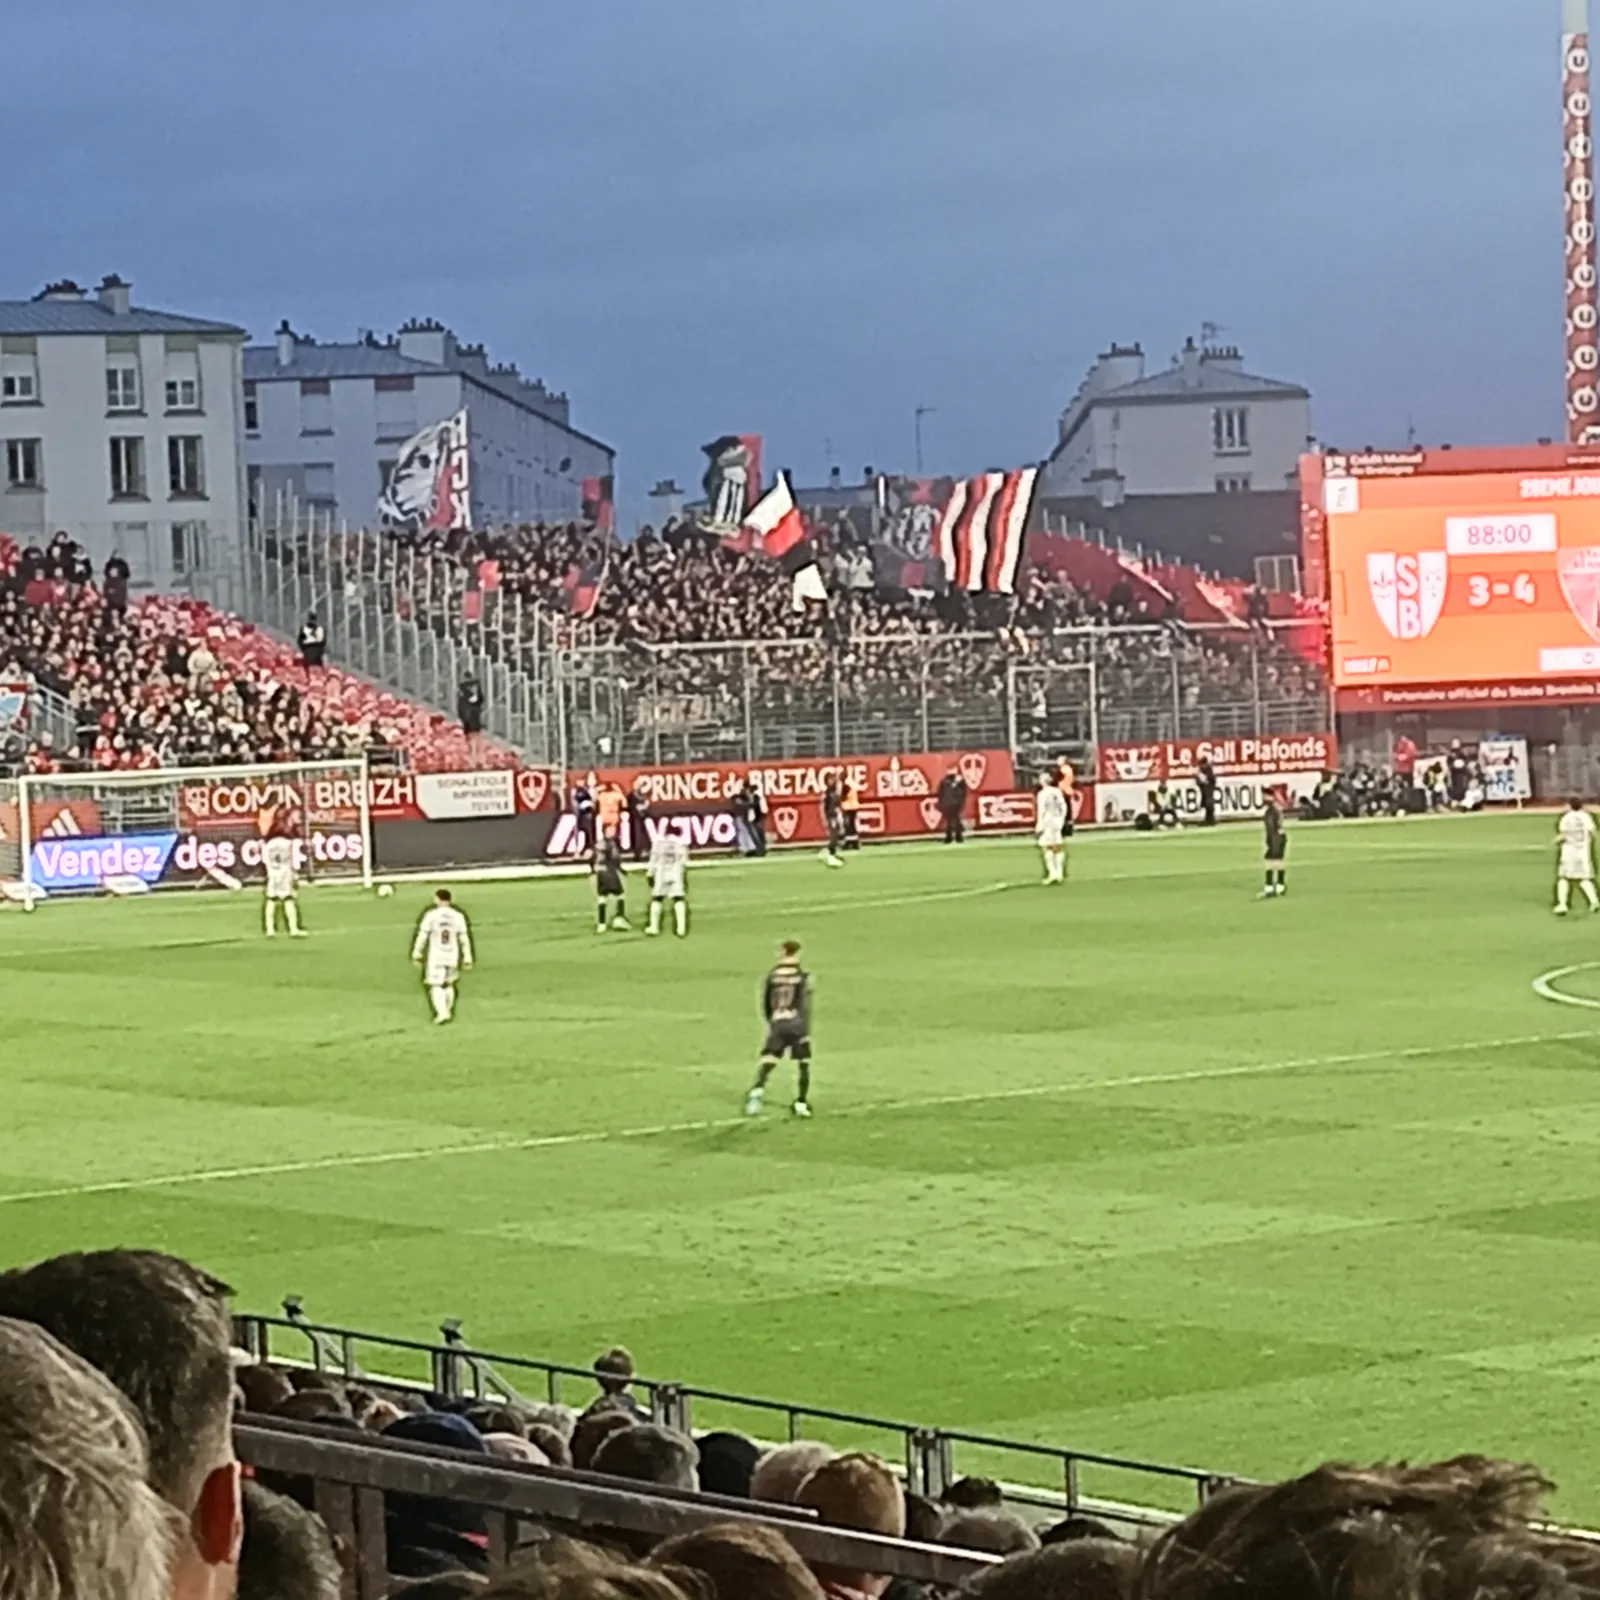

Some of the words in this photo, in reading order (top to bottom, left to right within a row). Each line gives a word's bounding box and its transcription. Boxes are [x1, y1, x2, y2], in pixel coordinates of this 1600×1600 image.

[1468, 524, 1531, 545] 88:00
[1167, 744, 1192, 765] Le
[1241, 738, 1326, 761] Plafonds
[633, 772, 721, 802] PRINCE
[35, 840, 163, 878] Vendez
[174, 835, 236, 870] des
